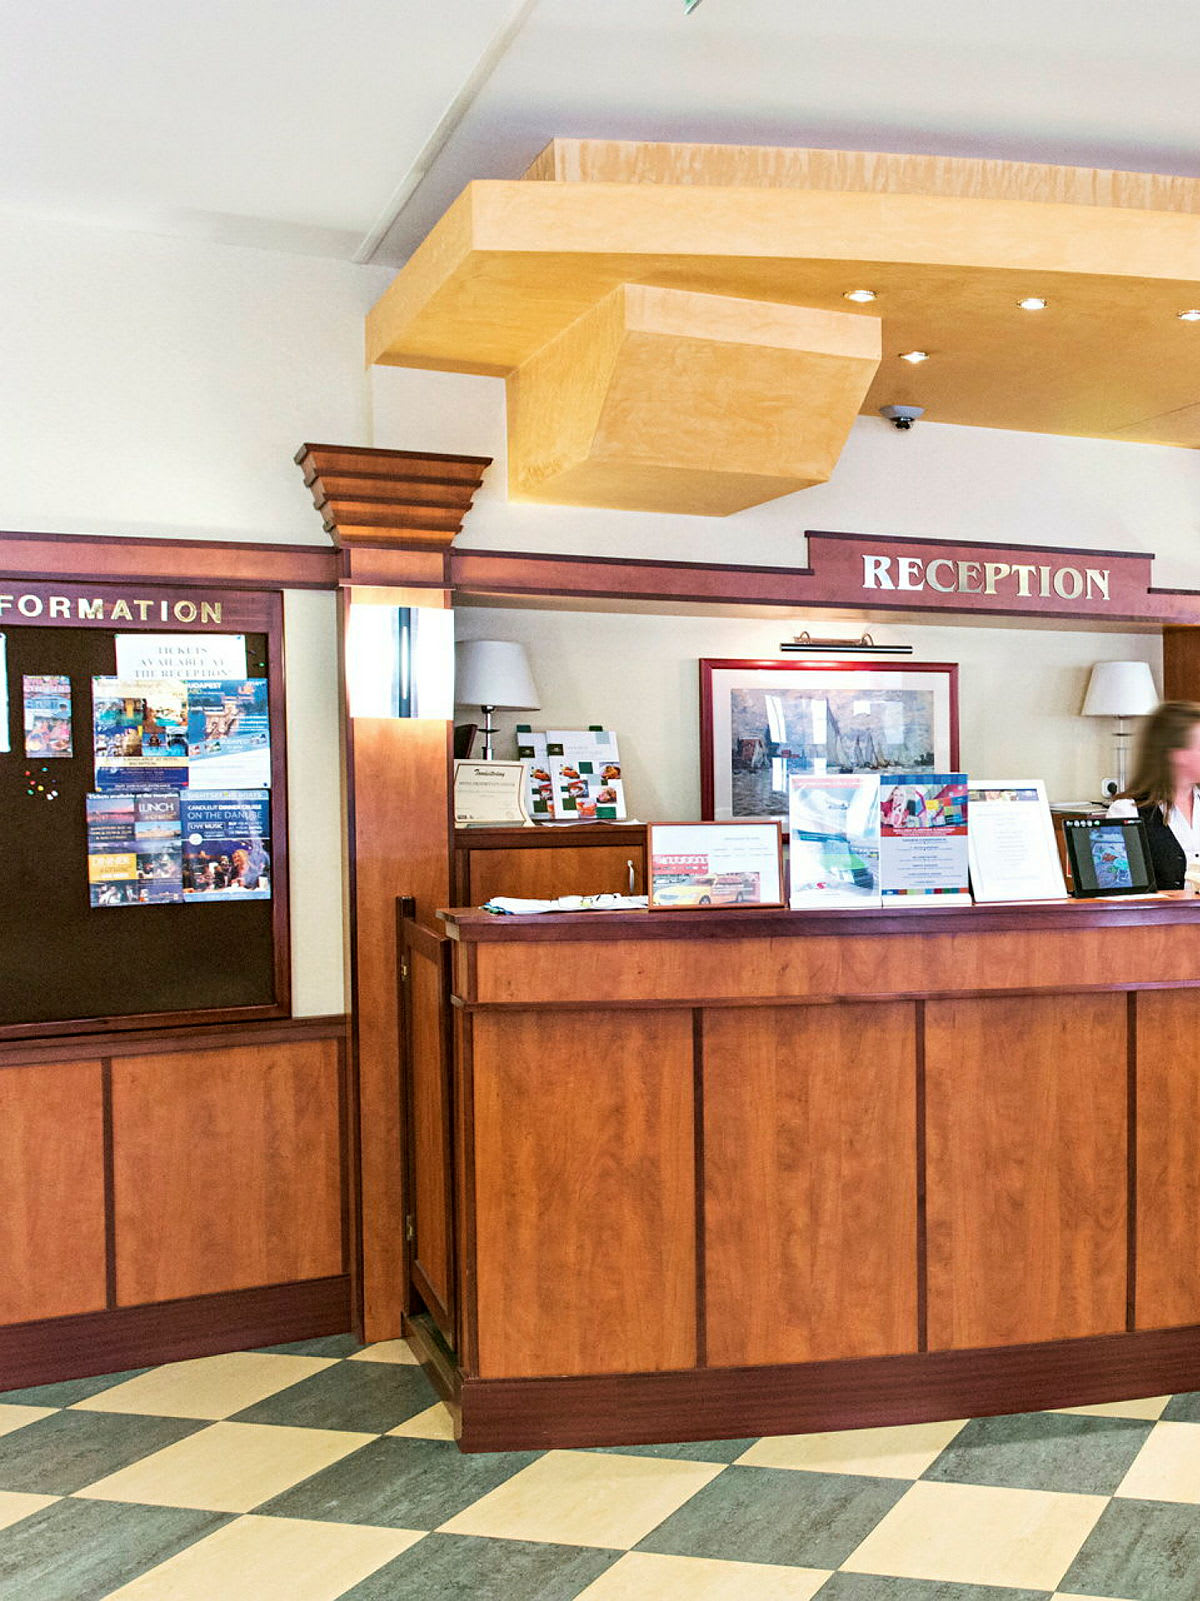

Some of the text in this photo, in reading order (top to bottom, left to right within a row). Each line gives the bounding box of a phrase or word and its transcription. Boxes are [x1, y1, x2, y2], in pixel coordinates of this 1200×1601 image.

[862, 554, 1110, 601] RECEPTION
[157, 646, 208, 654] TICKETS
[139, 658, 225, 667] AVAILABLE AT
[134, 669, 155, 678] THE
[139, 802, 174, 812] LUNCH
[187, 811, 202, 820] ON
[204, 811, 223, 819] THE
[224, 810, 263, 819] DANUBE
